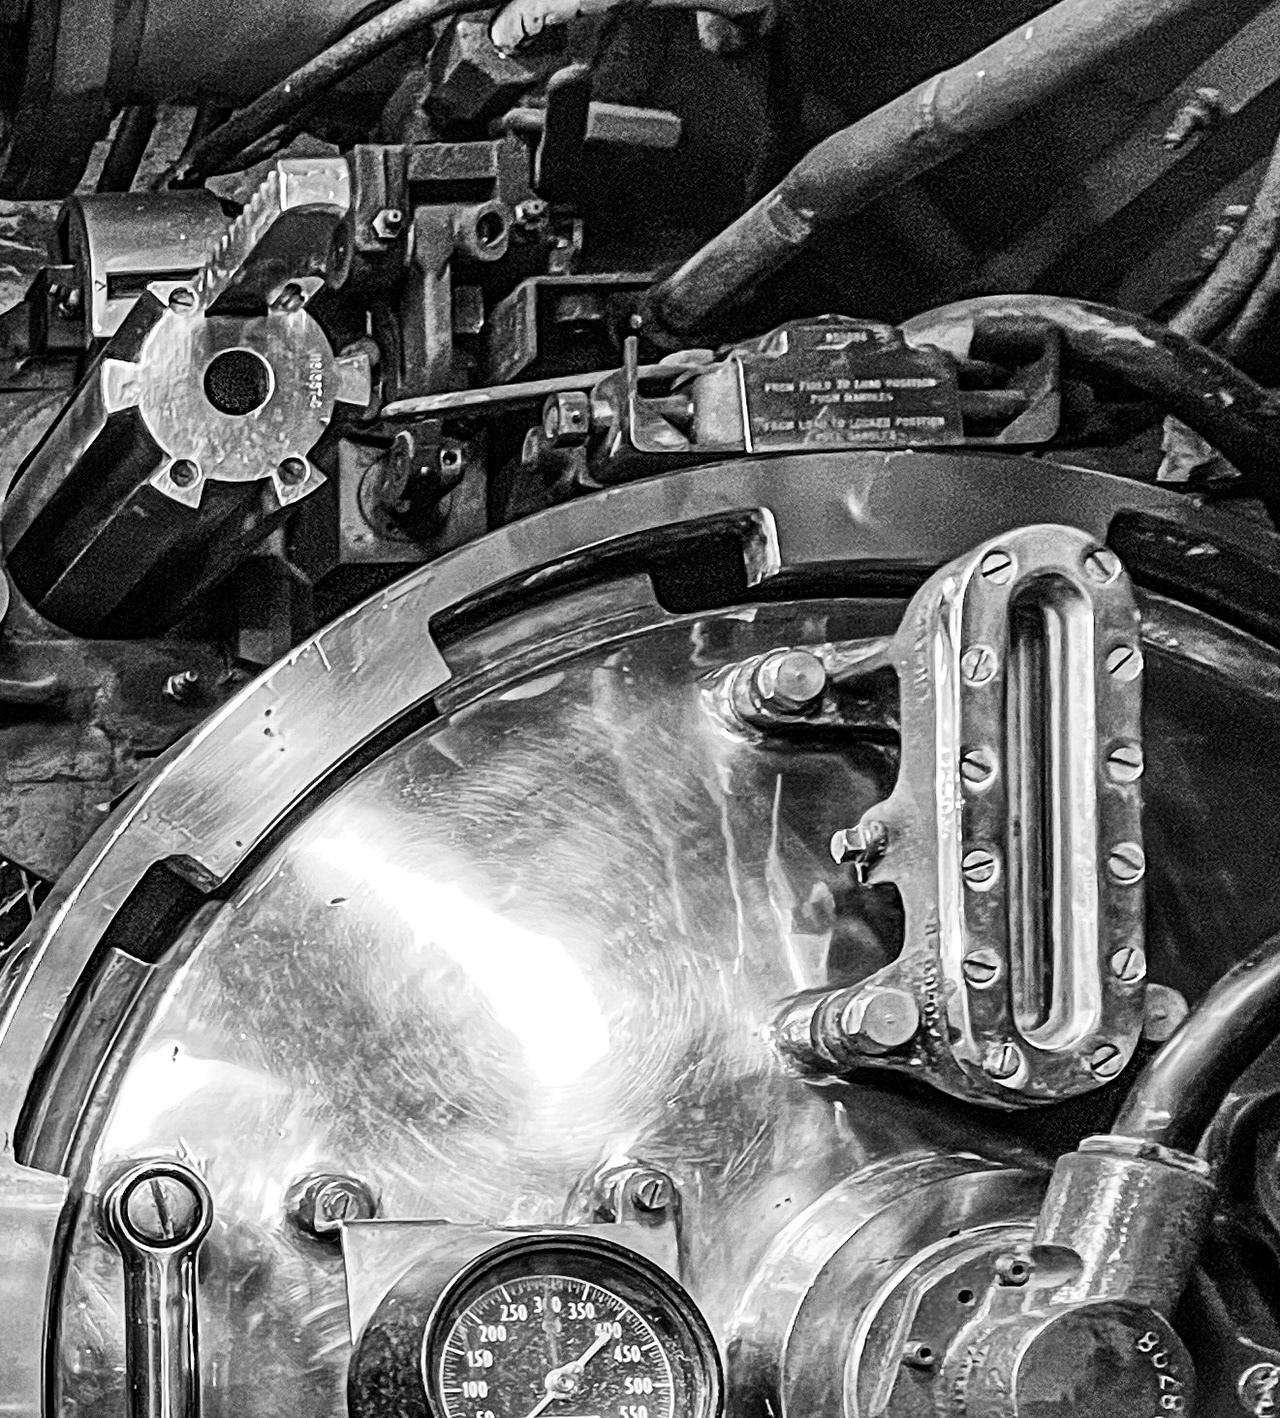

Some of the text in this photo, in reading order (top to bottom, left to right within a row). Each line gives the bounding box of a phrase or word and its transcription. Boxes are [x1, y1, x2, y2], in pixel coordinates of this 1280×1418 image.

[500, 1304, 527, 1321] 250
[568, 1302, 595, 1320] 350
[479, 1325, 507, 1342] 200
[467, 1350, 493, 1368] 150
[613, 1345, 641, 1363] 450
[462, 1381, 488, 1399] 100
[625, 1377, 653, 1395] 500
